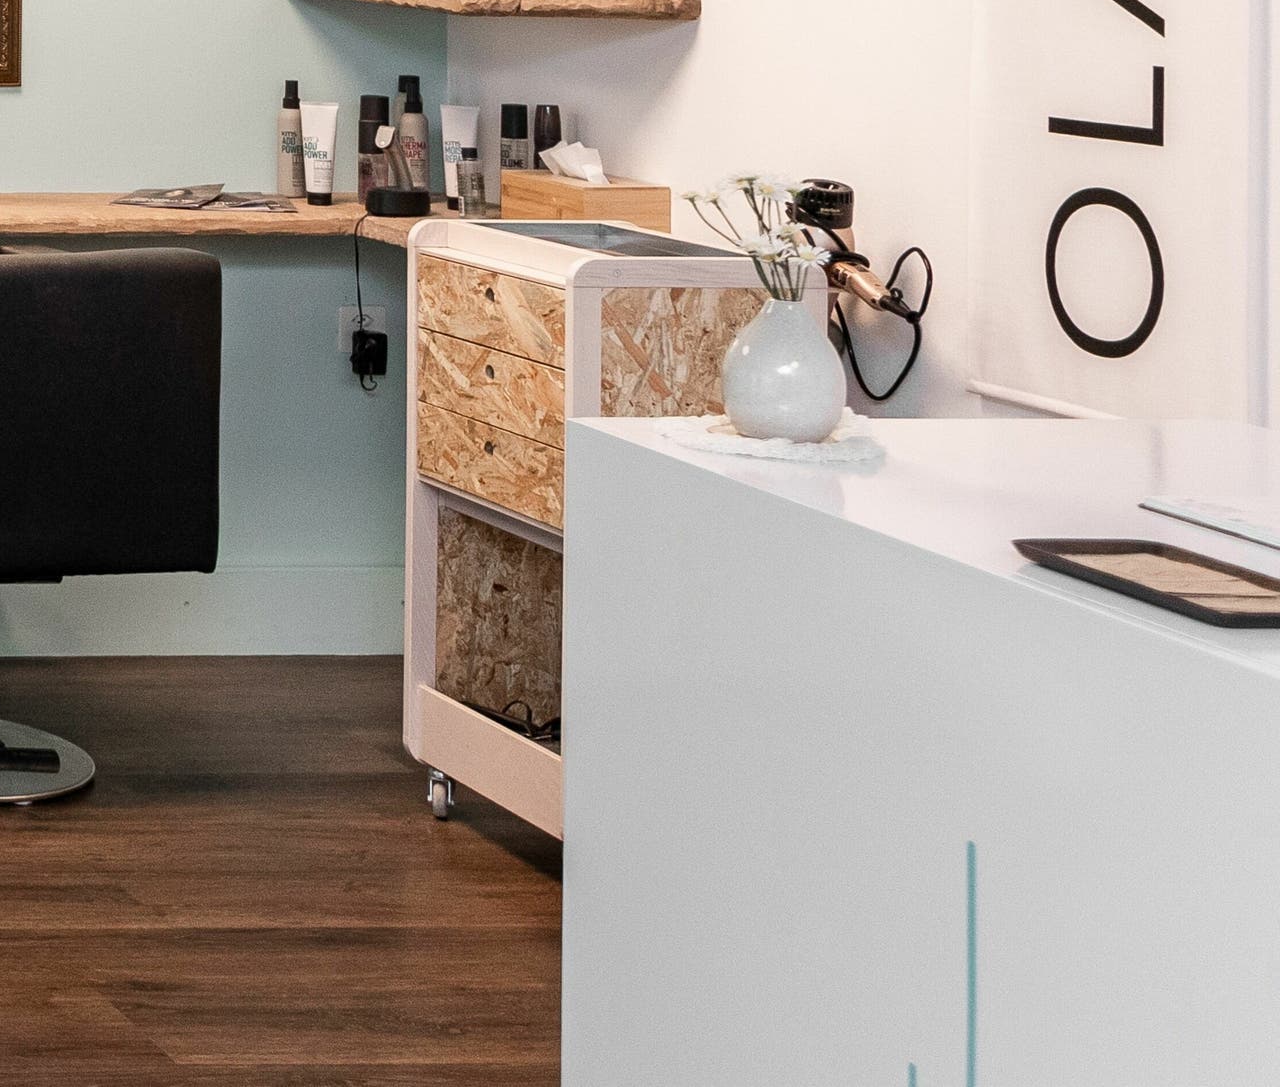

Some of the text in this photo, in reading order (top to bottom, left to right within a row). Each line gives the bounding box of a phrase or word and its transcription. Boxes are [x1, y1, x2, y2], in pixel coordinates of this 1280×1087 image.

[282, 136, 296, 145] ADD
[281, 144, 303, 154] POWE
[304, 150, 329, 160] POWER
